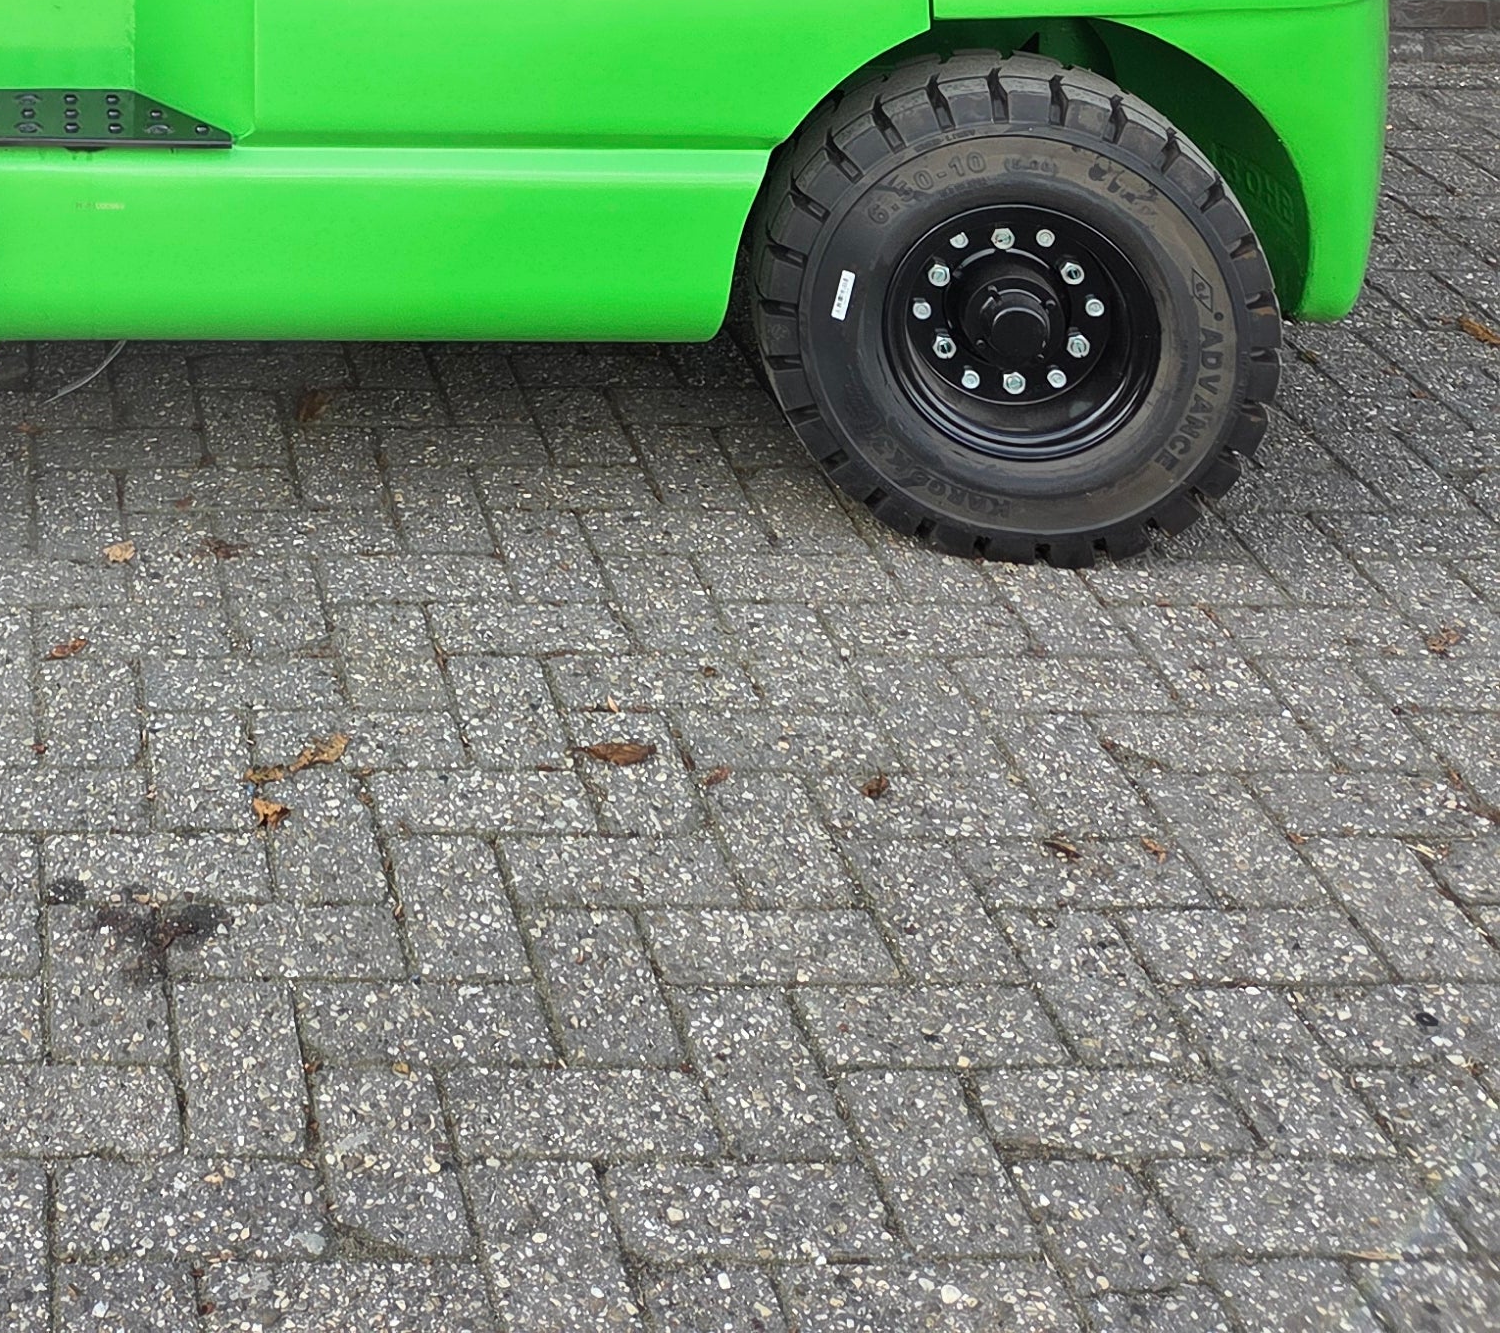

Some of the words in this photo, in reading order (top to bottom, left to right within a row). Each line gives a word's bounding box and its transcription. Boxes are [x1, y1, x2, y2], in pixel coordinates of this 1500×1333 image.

[867, 151, 987, 225] 6.50-10
[1153, 327, 1225, 472] ADVANCE
[905, 470, 1012, 518] KARGO
